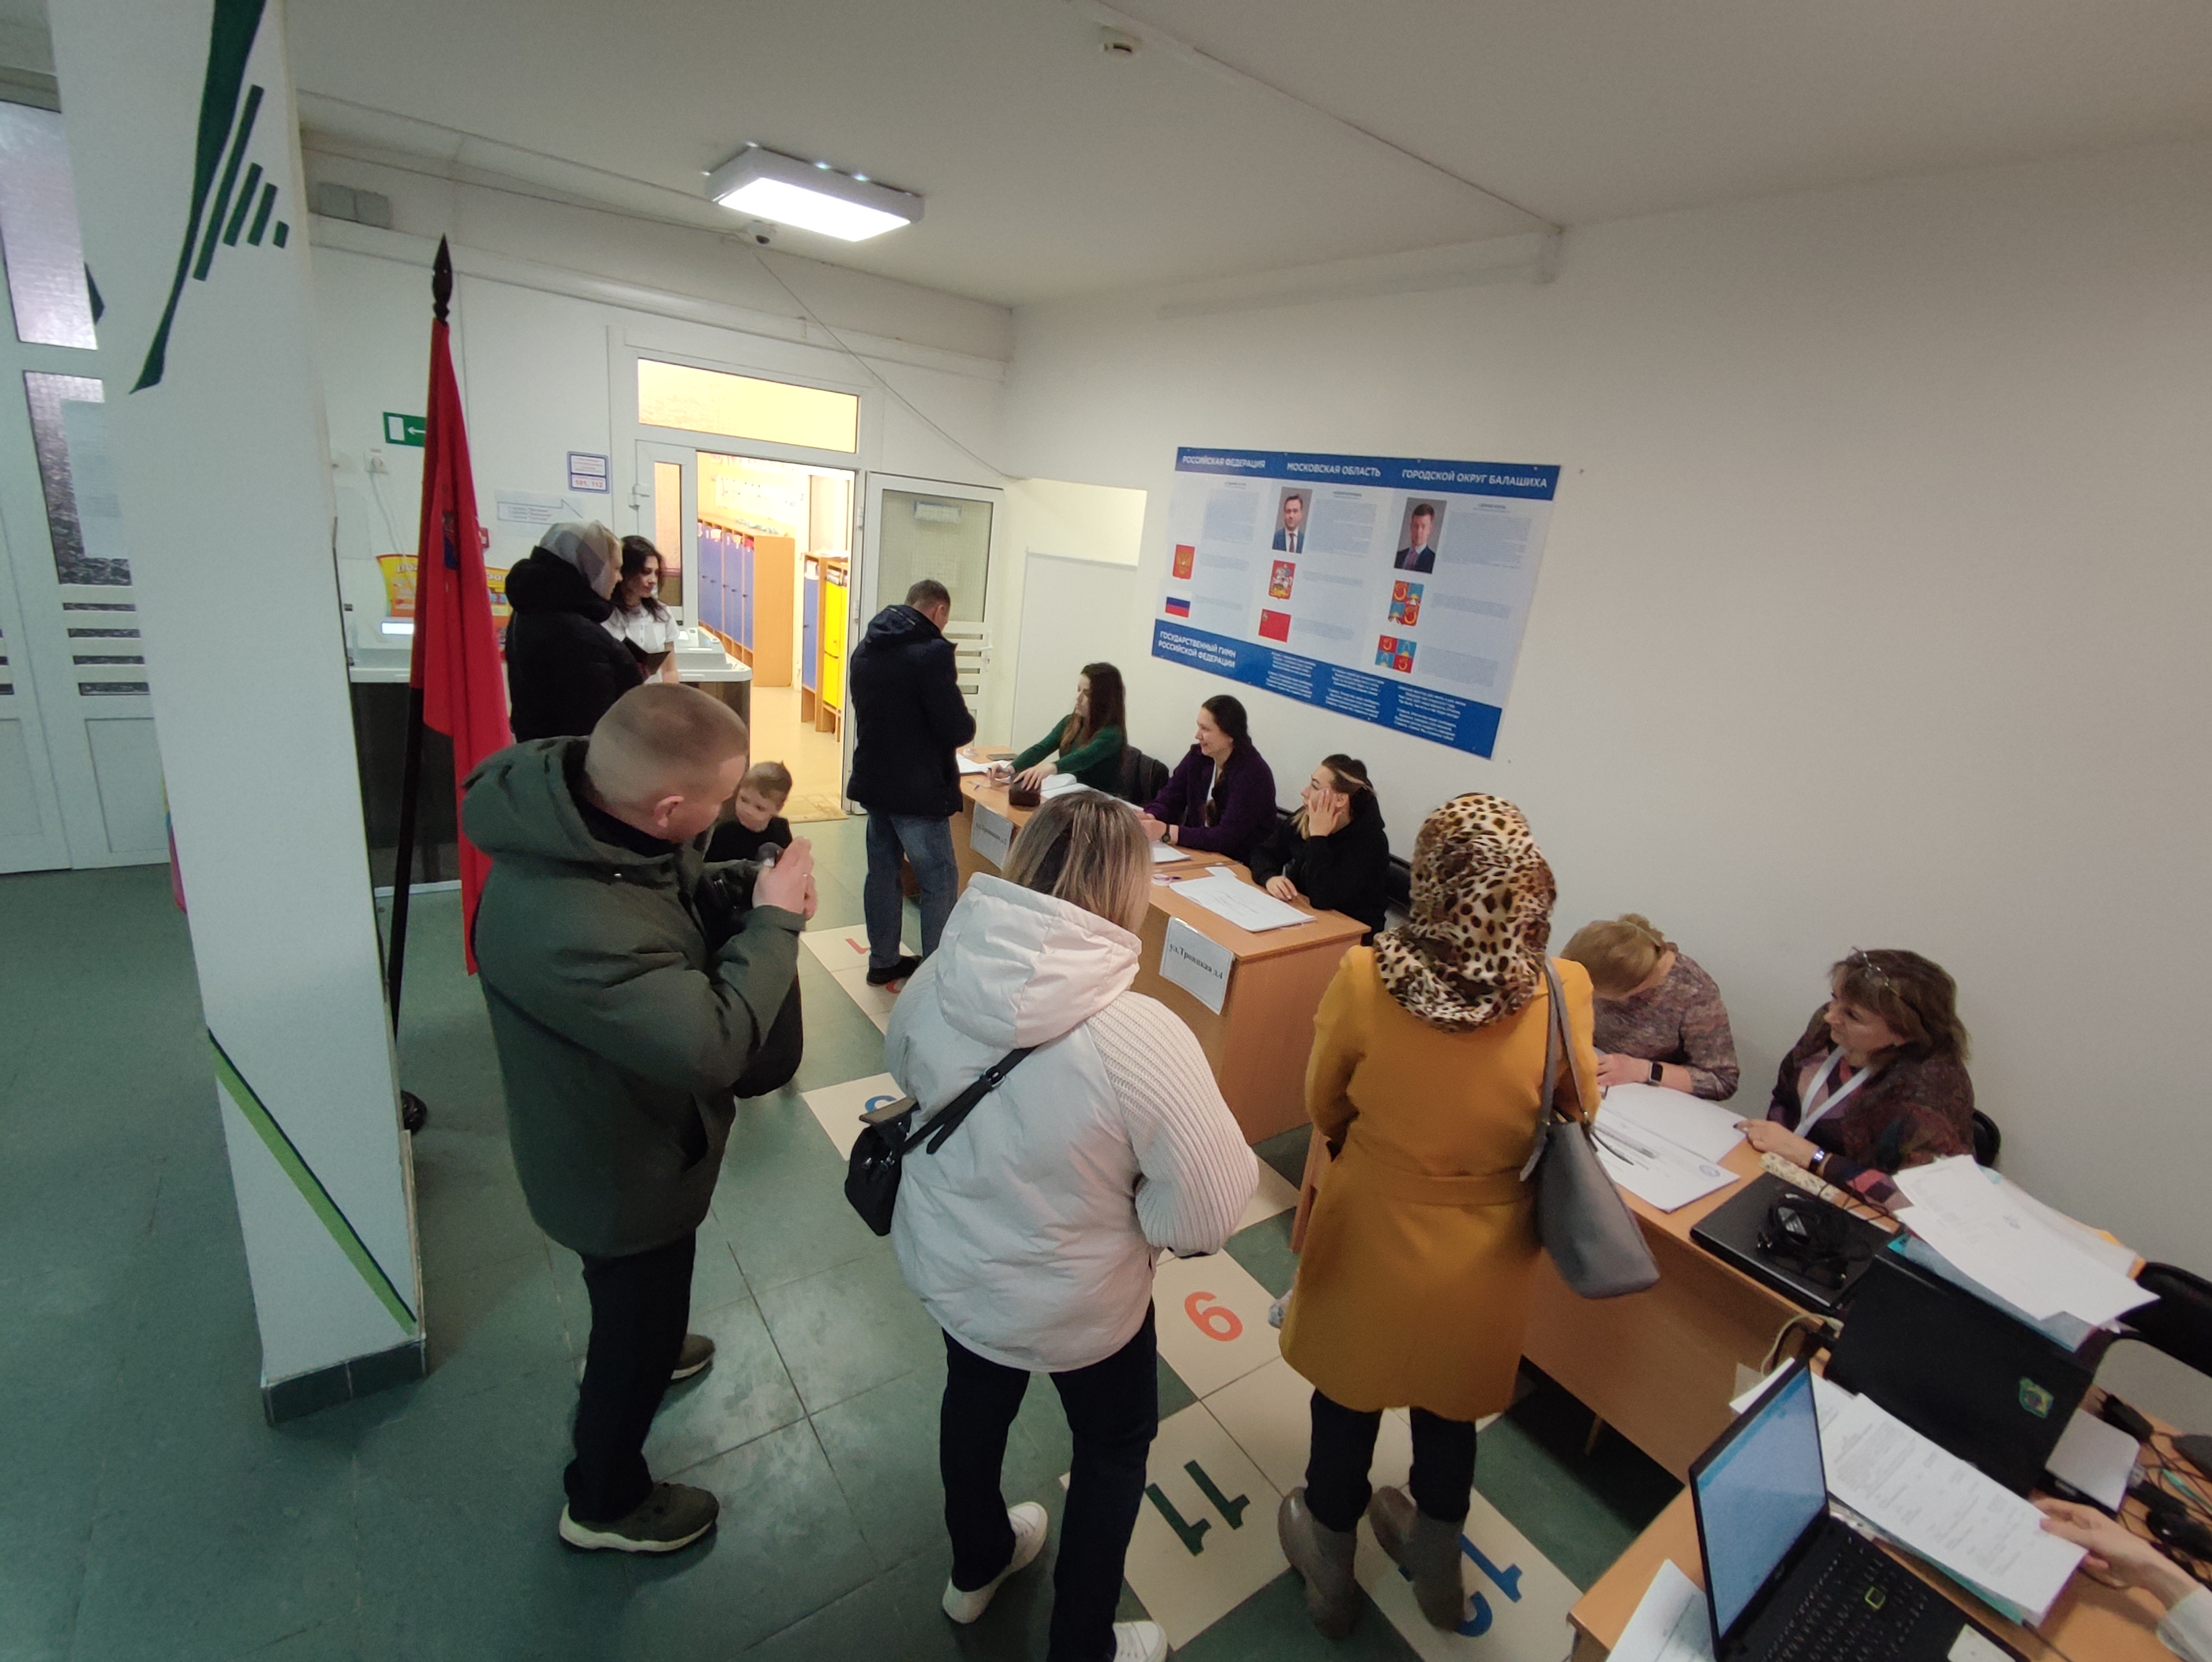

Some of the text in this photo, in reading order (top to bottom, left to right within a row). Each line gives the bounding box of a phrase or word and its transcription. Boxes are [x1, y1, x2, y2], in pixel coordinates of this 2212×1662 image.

[1182, 455, 1265, 469] РОССИЙСКАЯ ФЕДЕРАЦИЯ
[1287, 462, 1381, 477] МОСКОВСКАЯ ОБЛАСТЬ
[1401, 469, 1548, 488] ГОРОДСКОЙ ОКРУГ БАЛАШИХА
[1159, 640, 1235, 668] РОССИЙСКОЙ ФЕДЕРАЦИИ
[1160, 631, 1236, 658] ГОСУДАРСТВЕННЫЙ ГИМН
[1146, 1460, 1250, 1557] 11
